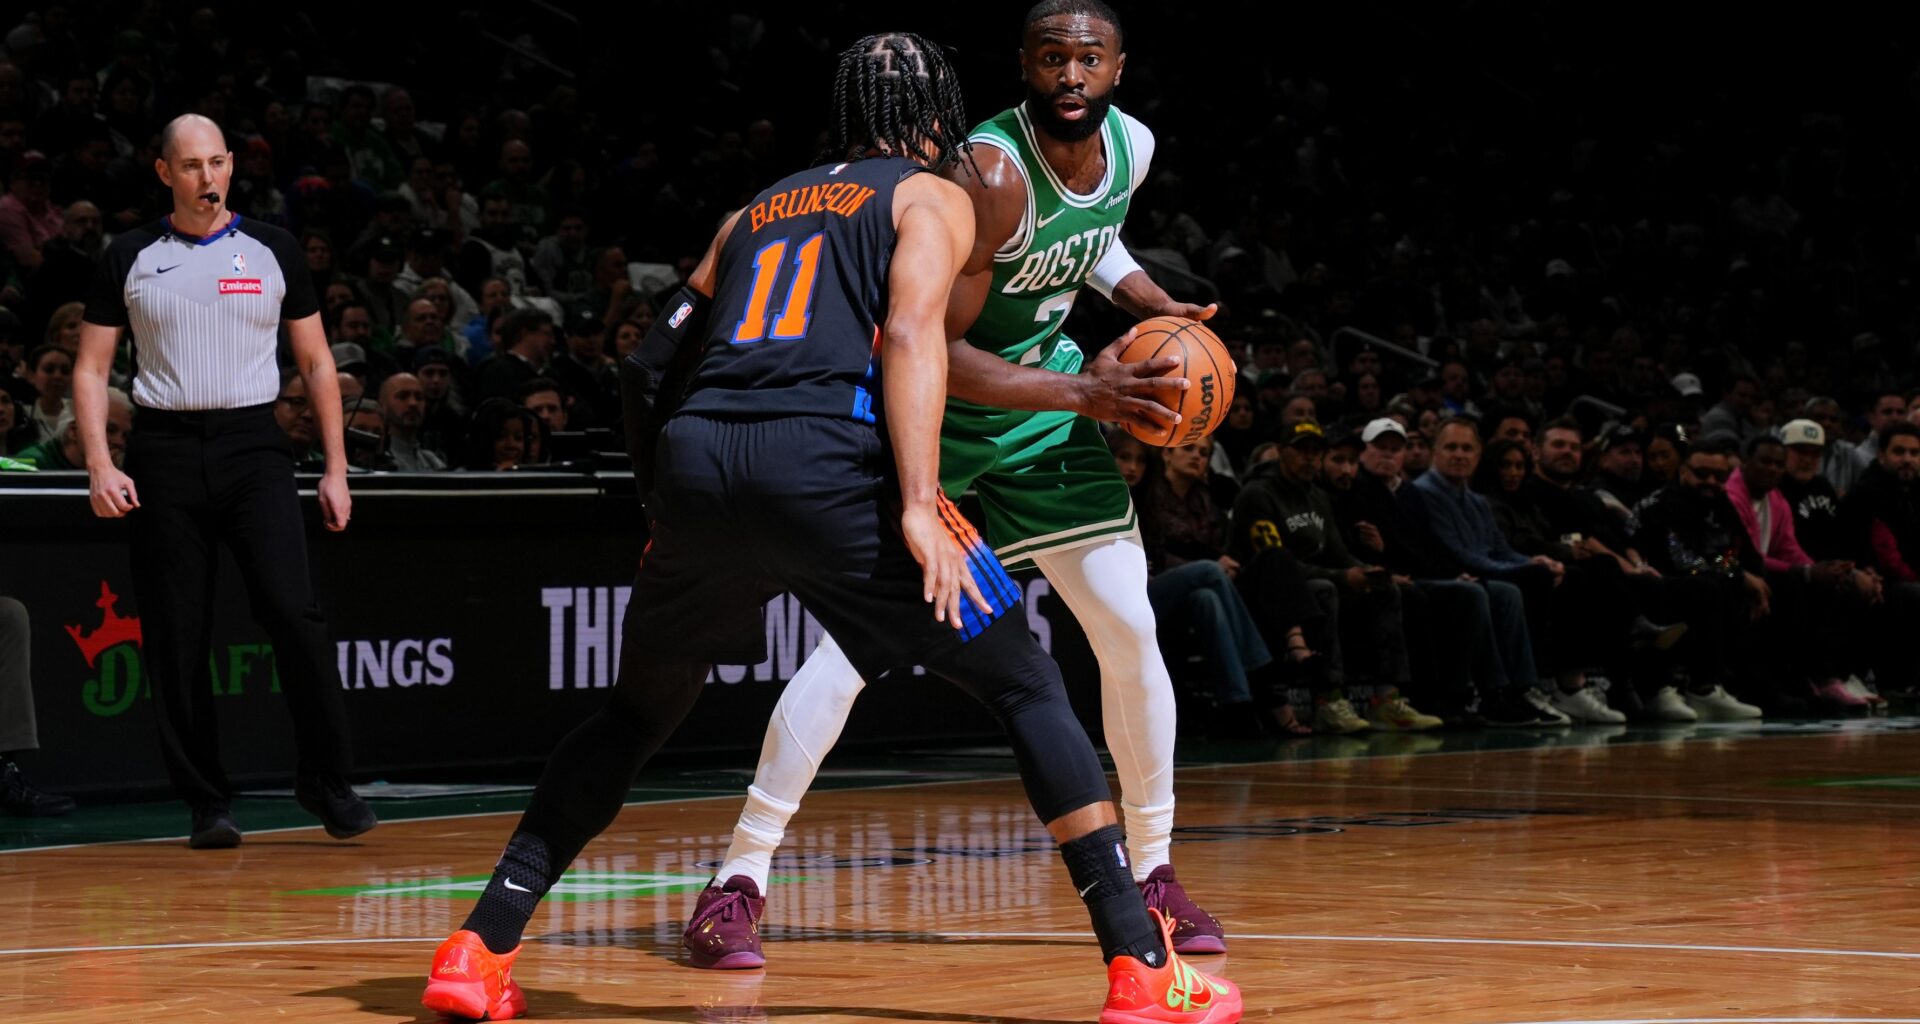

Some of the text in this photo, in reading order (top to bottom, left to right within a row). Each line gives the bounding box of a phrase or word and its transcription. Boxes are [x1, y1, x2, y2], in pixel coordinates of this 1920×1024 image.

[751, 182, 876, 233] BRUNSON
[220, 281, 262, 292] Emirates
[729, 229, 826, 345] 11
